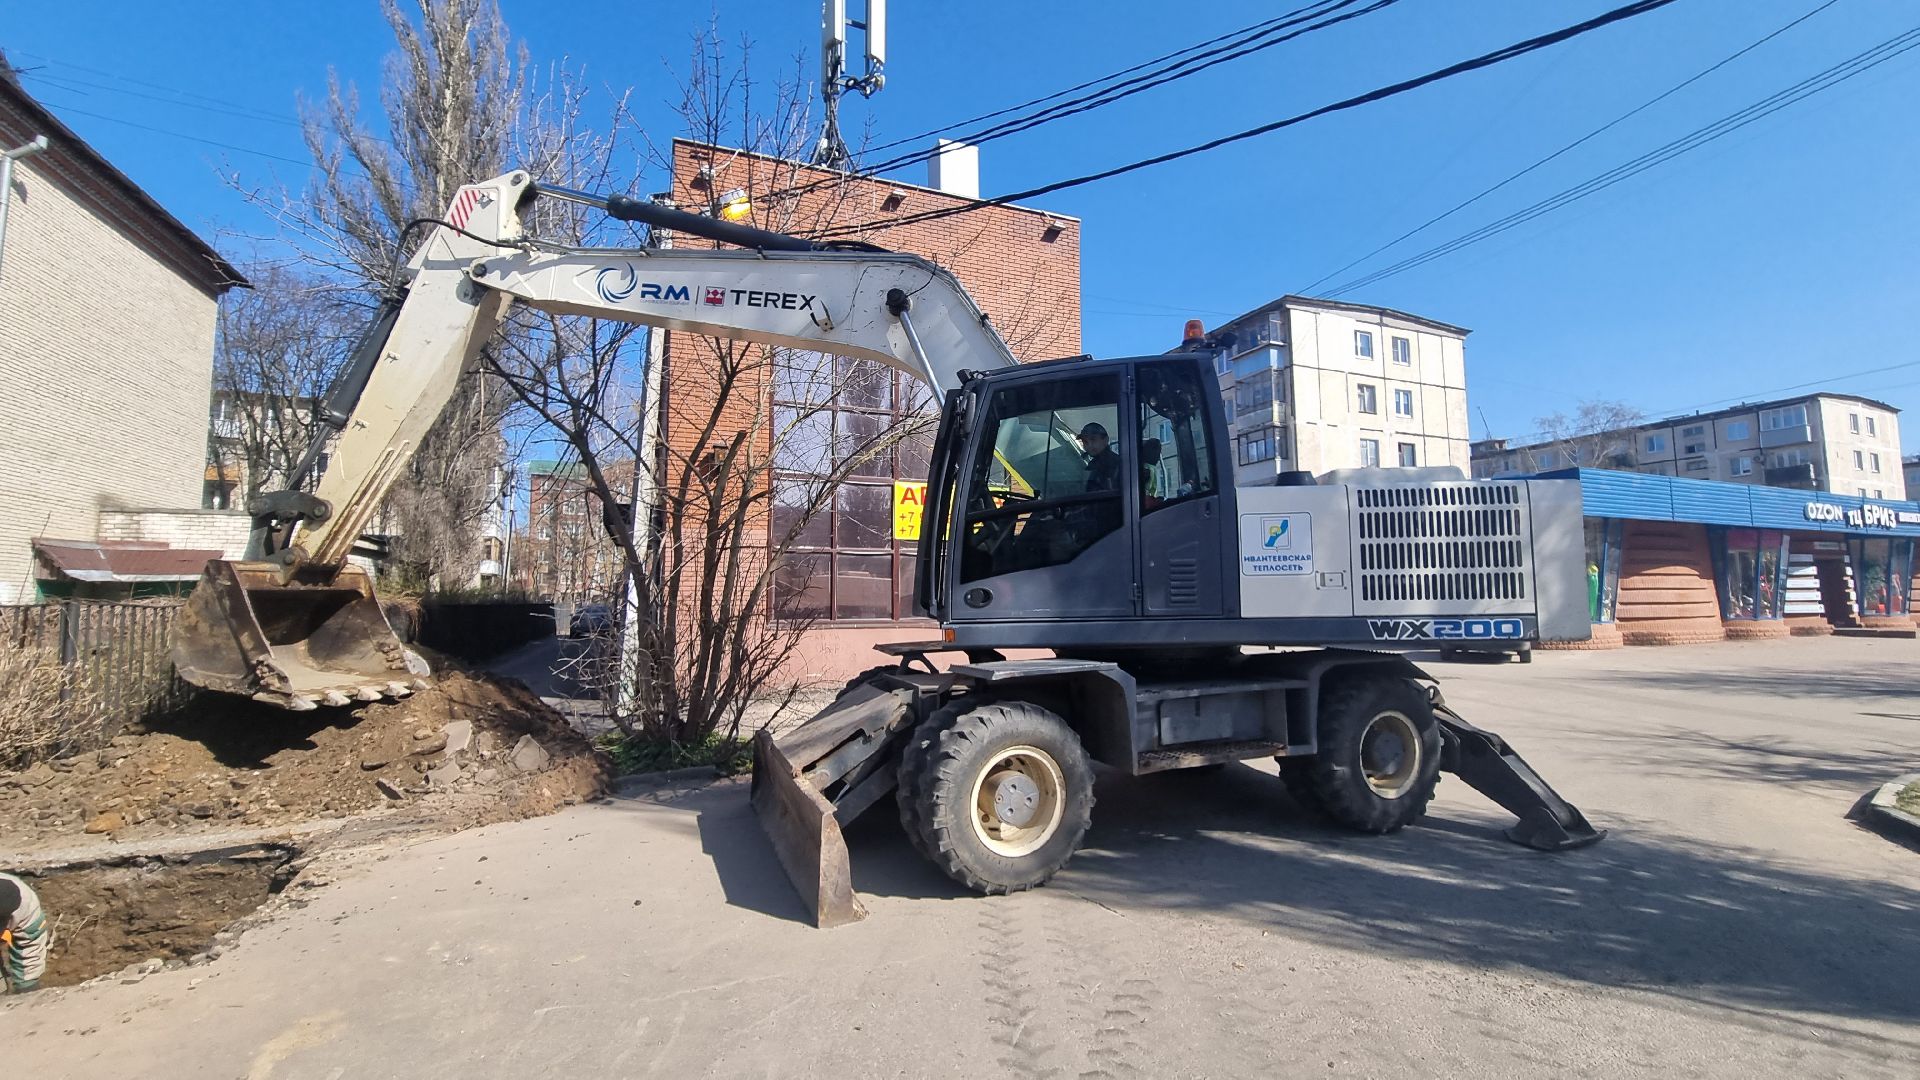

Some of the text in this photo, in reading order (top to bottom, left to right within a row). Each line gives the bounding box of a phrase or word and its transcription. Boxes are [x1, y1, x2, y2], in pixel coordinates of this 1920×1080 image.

[640, 283, 817, 311] RM TEREX
[899, 512, 915, 523] +7
[1805, 501, 1844, 521] OZON
[1863, 504, 1897, 529] БРИЗ
[899, 525, 915, 537] +7
[1243, 554, 1312, 562] ИВАНТЕЕВСКАЯ
[1253, 564, 1304, 572] ТЕПЛОСЕТЬ
[1367, 618, 1524, 641] WX200
